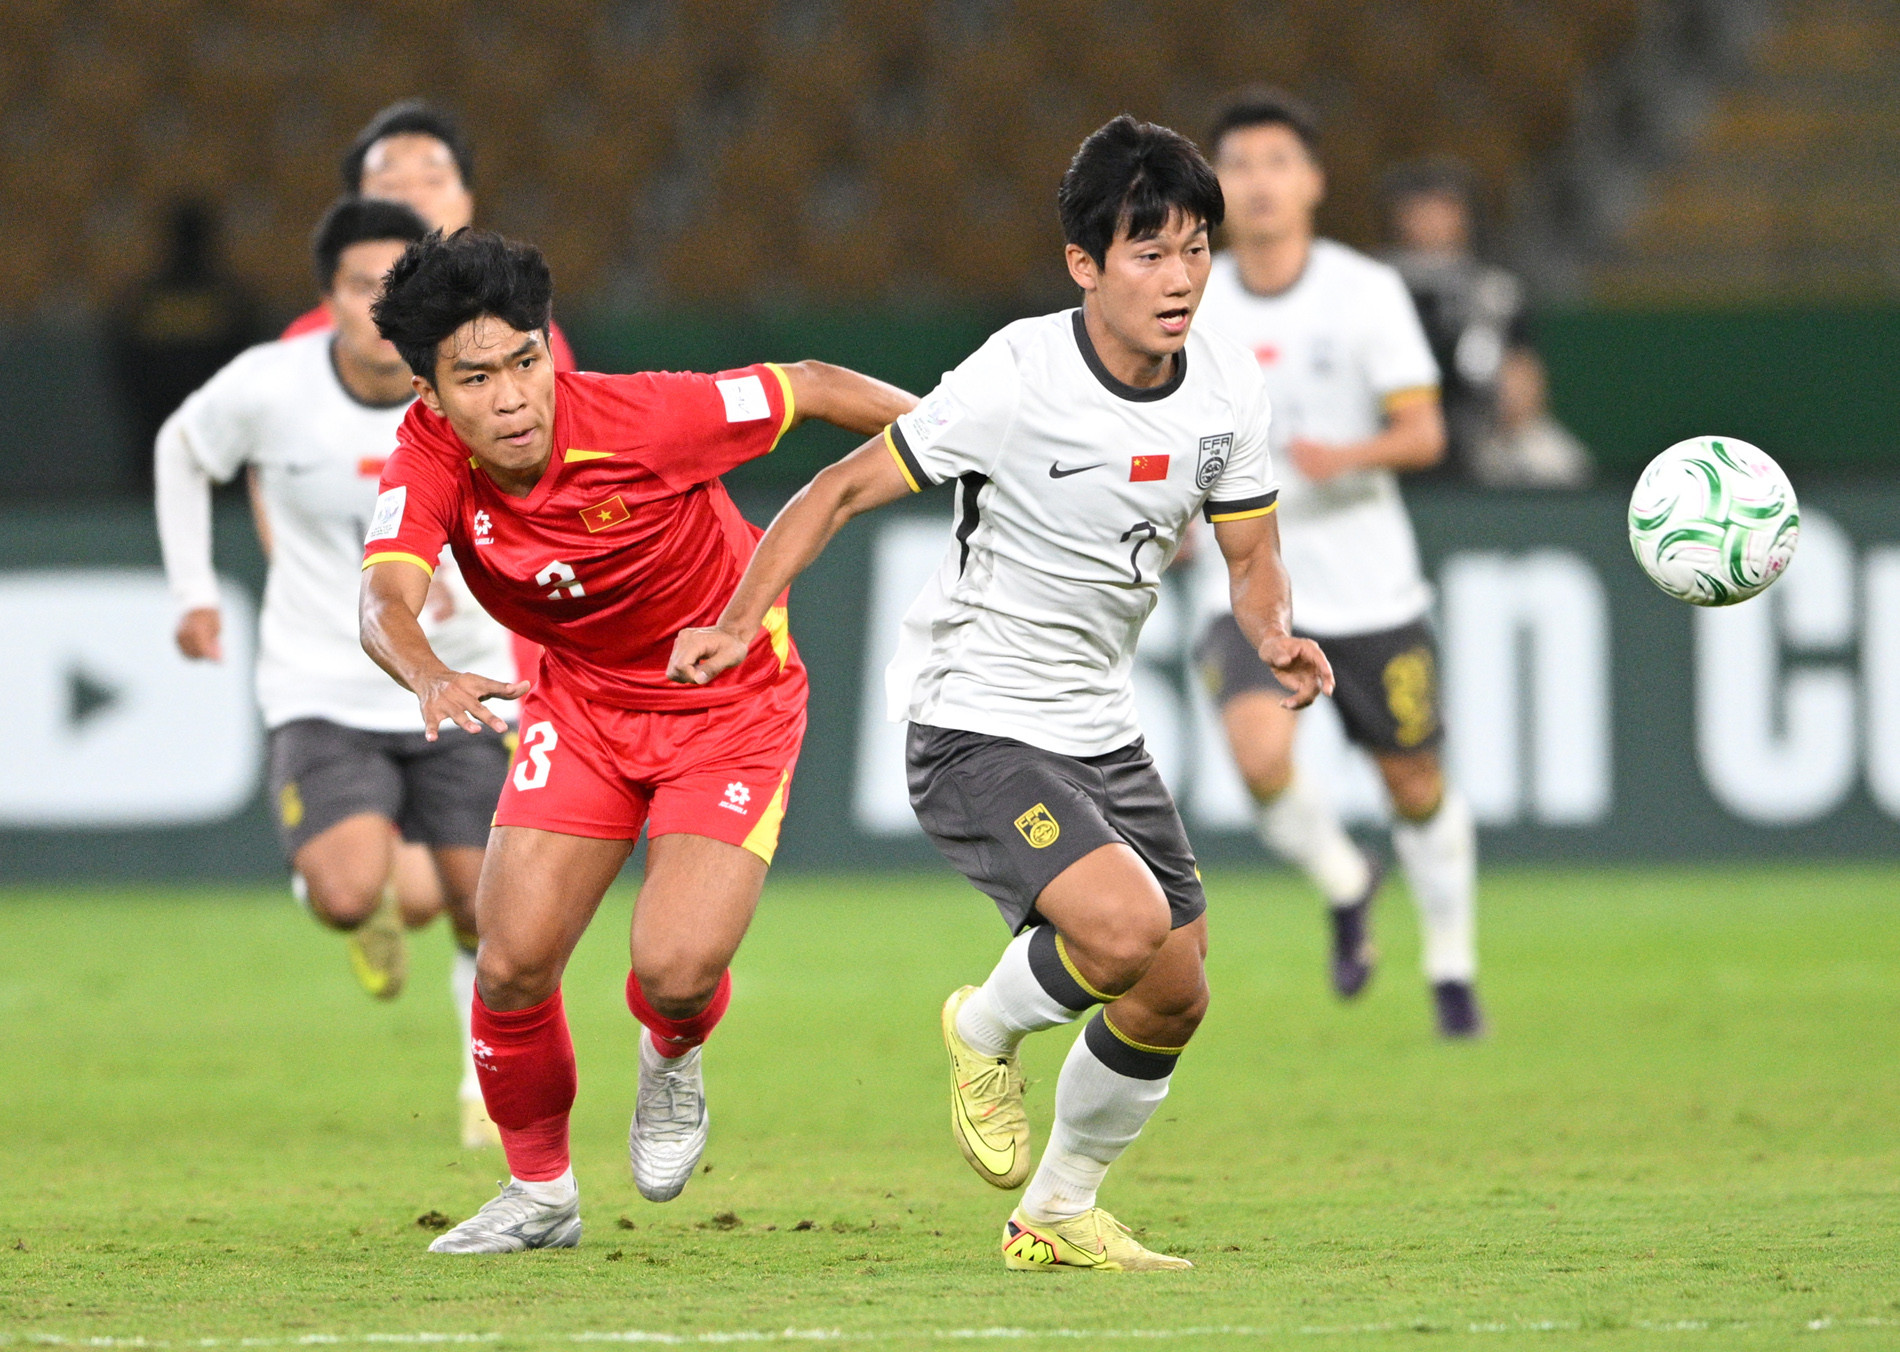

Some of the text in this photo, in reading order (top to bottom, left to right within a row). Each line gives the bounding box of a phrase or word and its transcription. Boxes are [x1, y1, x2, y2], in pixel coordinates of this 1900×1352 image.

[1202, 436, 1230, 451] CFA
[535, 559, 587, 601] 3
[512, 720, 559, 792] 3
